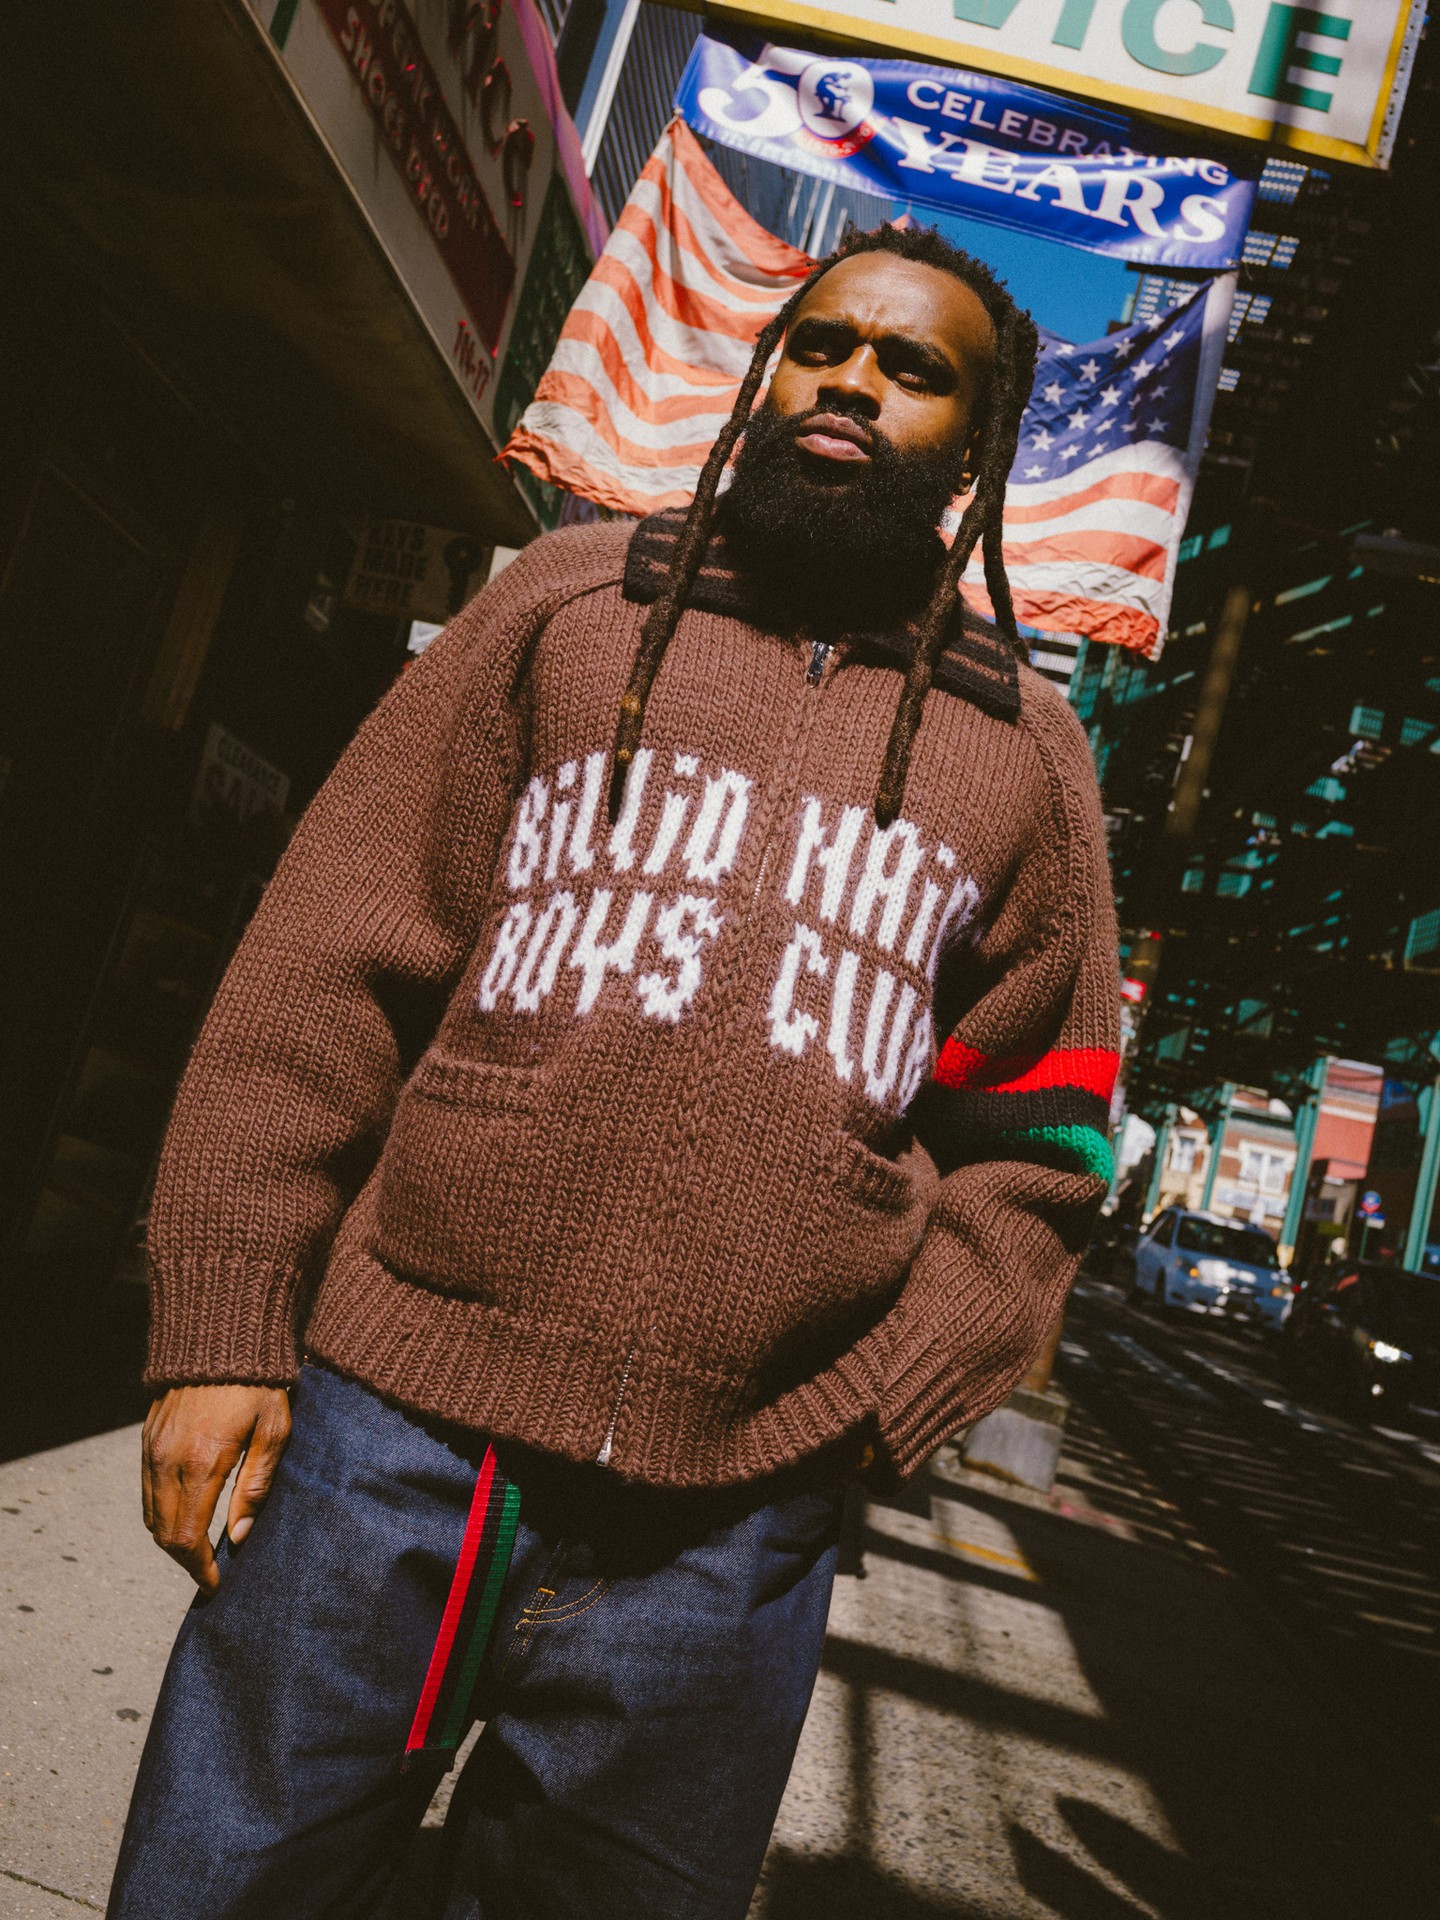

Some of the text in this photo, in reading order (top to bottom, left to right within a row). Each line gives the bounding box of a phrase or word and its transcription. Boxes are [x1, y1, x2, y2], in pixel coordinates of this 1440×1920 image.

[892, 117, 1229, 243] YEARS
[907, 80, 1229, 186] CELEBRATING
[480, 886, 726, 1024] BOYS
